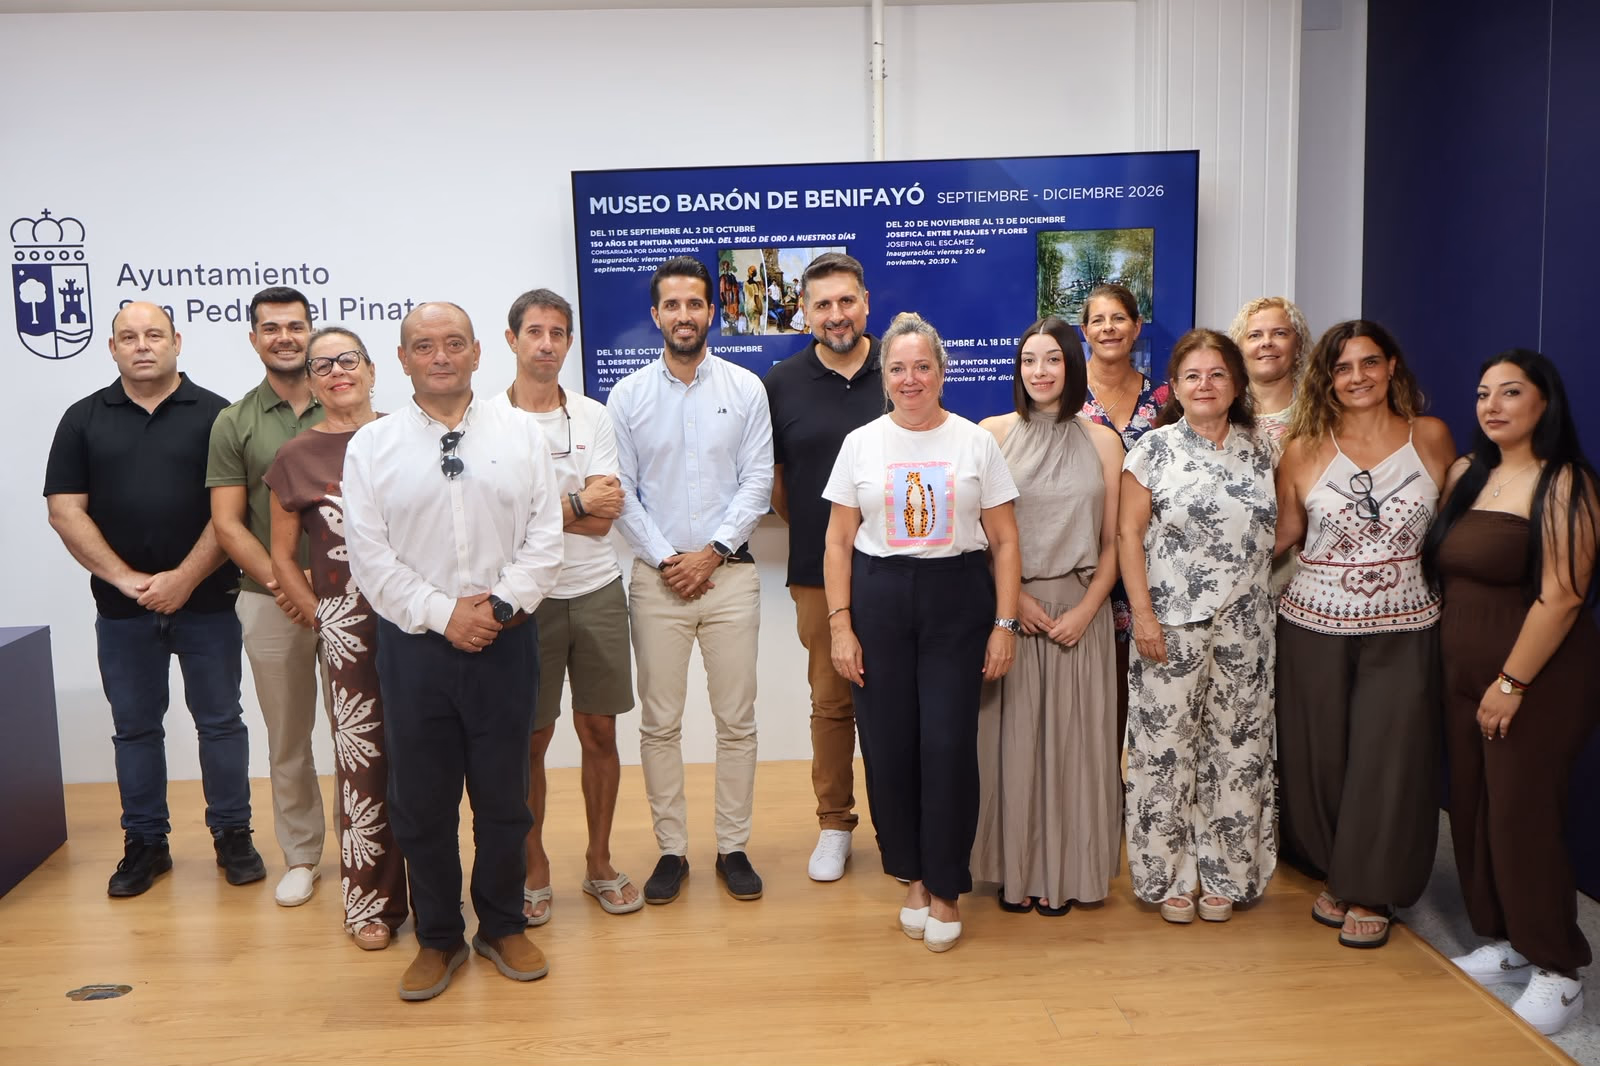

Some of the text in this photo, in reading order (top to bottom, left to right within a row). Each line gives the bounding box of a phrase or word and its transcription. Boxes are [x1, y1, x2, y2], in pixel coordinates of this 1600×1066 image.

[589, 195, 671, 215] MUSEO
[677, 188, 760, 212] BARÓN
[767, 191, 798, 210] DE
[804, 182, 925, 208] BENIFAYÓ
[937, 189, 1029, 204] SEPTIEMBRE
[1043, 186, 1124, 201] DICIEMBRE
[1128, 184, 1165, 199] 2026
[904, 220, 915, 228] 20
[930, 218, 981, 227] NOVIEMBRE
[1006, 217, 1018, 225] DE
[1020, 215, 1066, 224] DICIEMBRE
[590, 229, 607, 237] DEL
[630, 227, 681, 236] SEPTIEMBRE
[702, 226, 714, 234] DE
[716, 225, 756, 233] OCTUBRE
[953, 228, 989, 236] PAISAJES
[998, 227, 1028, 235] FLORES
[605, 239, 626, 248] AÑOS
[640, 239, 673, 247] PINTURA
[675, 238, 717, 246] MURCIANA.
[718, 236, 733, 244] DEL
[734, 236, 757, 244] SIGLO
[758, 235, 769, 243] DE
[796, 233, 836, 241] NUESTROS
[837, 232, 856, 240] DÍAS
[886, 238, 975, 248] JOSEFINA GIL ESCÁMEZ
[591, 248, 633, 256] COMISARIADA
[886, 249, 936, 257] Inauguración:
[937, 248, 963, 256] viernes
[592, 256, 640, 265] Inauguración:
[641, 255, 667, 263] viernes
[886, 259, 926, 267] noviembre,
[594, 266, 636, 274] septiembre,
[116, 262, 330, 291] Ayuntamiento
[186, 298, 251, 323] Pedr
[308, 297, 327, 321] el
[990, 338, 998, 346] 18
[624, 348, 636, 356] DE
[714, 345, 763, 353] NOVIEMBRE
[943, 375, 976, 383] iércoless
